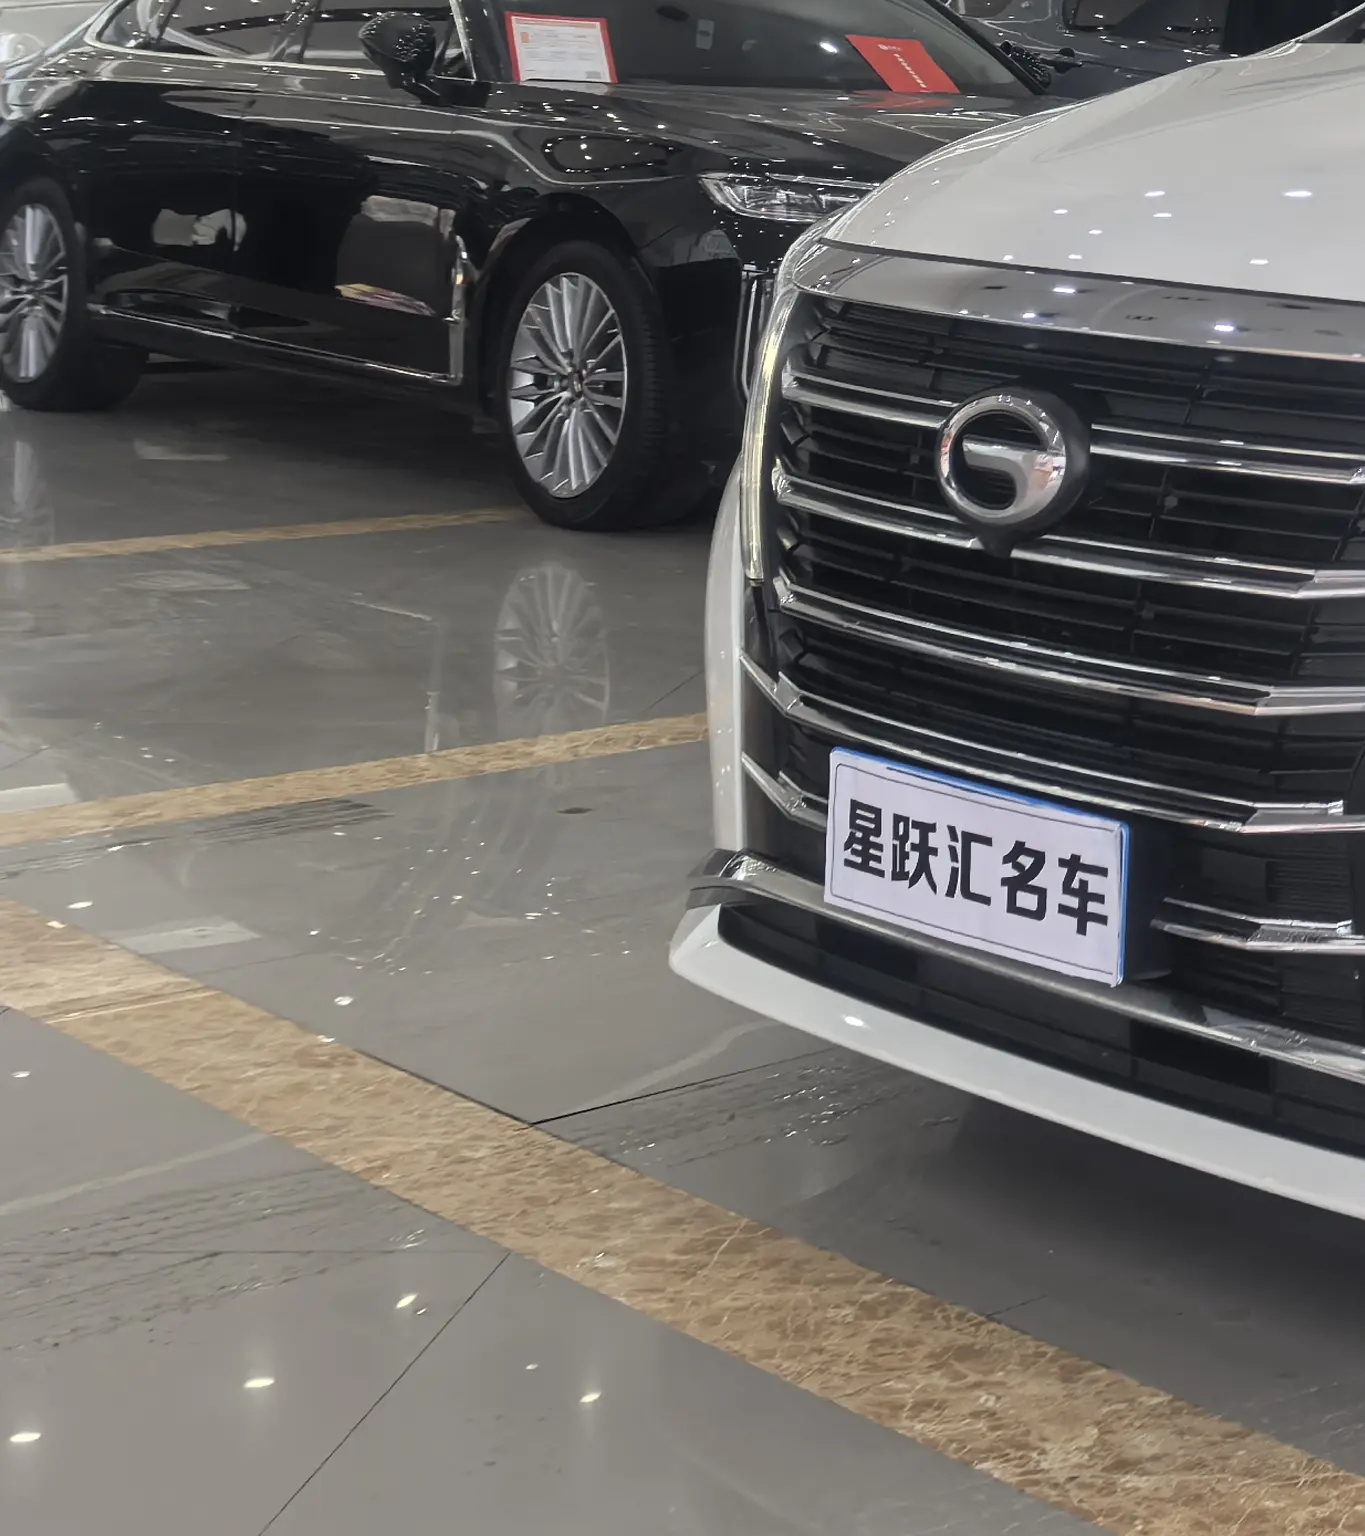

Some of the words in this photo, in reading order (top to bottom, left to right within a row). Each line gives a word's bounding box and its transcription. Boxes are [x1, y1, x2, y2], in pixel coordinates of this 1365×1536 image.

[842, 798, 1109, 937] 星跃汇名车
